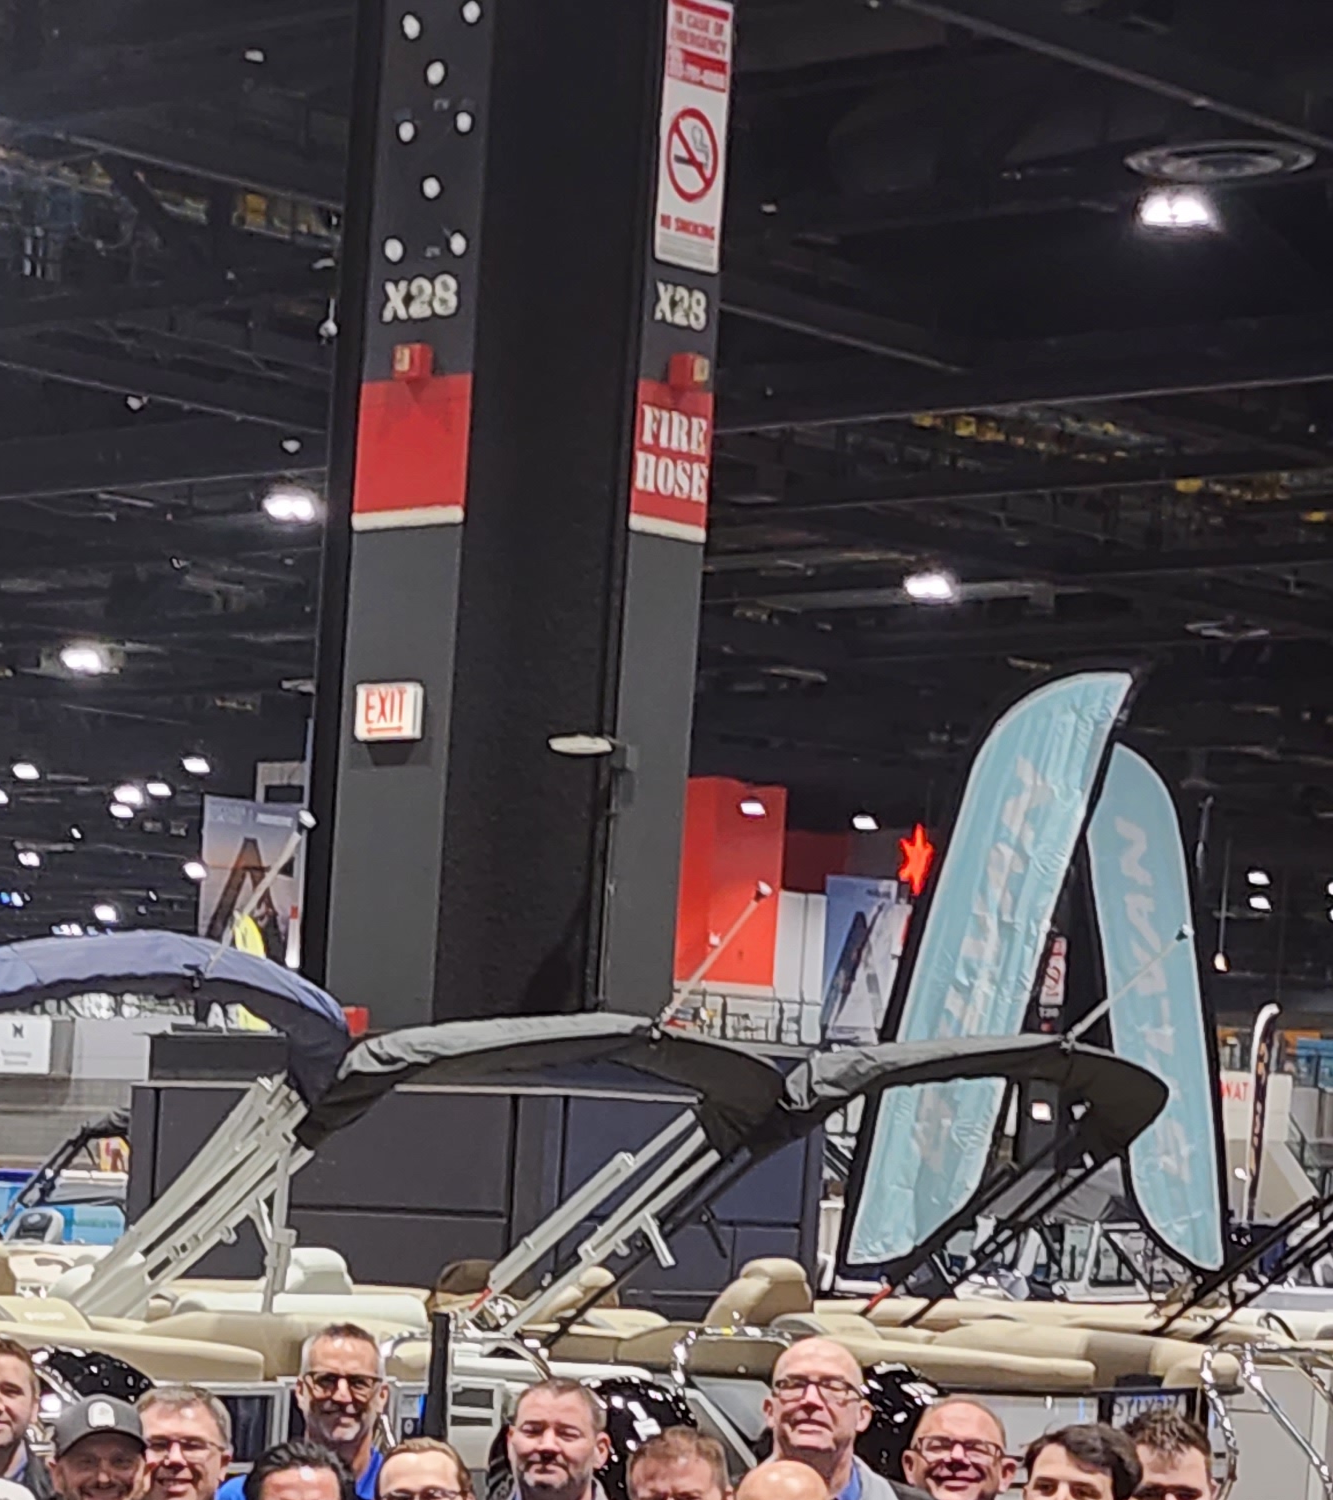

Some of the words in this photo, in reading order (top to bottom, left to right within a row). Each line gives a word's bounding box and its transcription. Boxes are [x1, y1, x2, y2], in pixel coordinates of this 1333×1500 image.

[381, 273, 459, 323] X28
[654, 280, 707, 332] X28
[641, 403, 708, 457] FIRE
[635, 450, 709, 502] HOSE
[363, 685, 408, 725] EXIT
